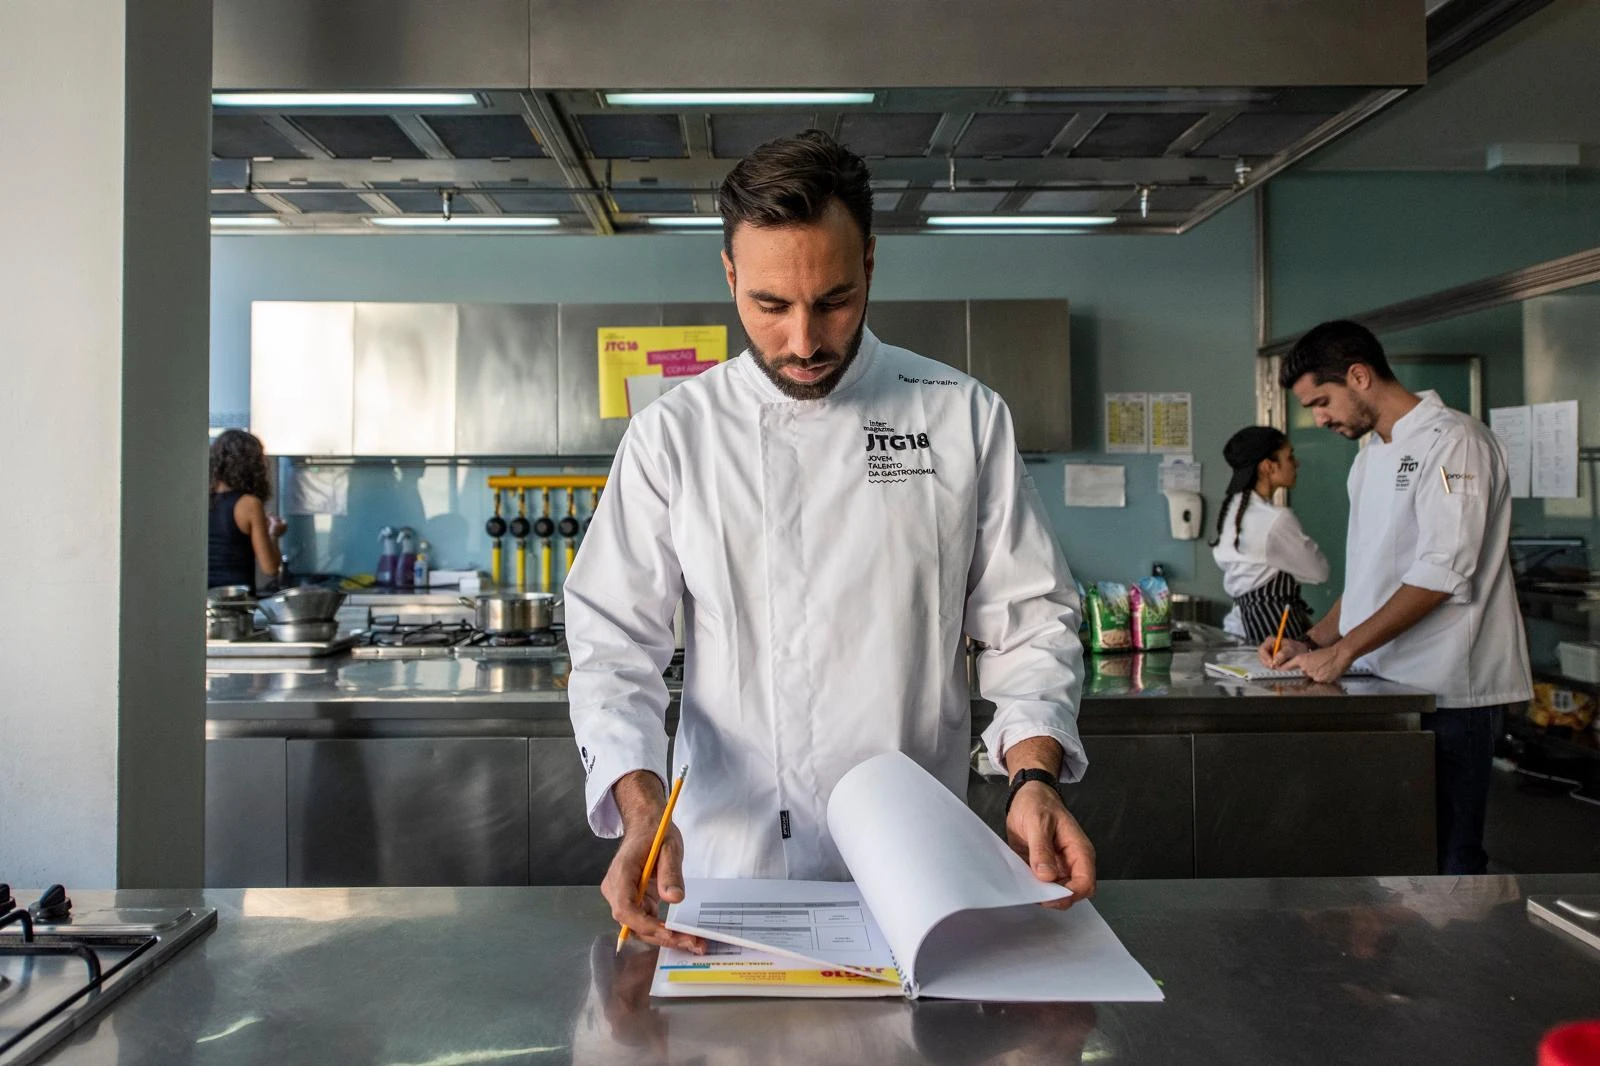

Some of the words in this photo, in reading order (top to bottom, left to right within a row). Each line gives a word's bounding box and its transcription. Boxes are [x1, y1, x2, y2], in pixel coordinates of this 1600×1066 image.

[898, 374, 920, 384] Paulo
[866, 432, 930, 451] JTG18
[881, 468, 937, 477] GASTRONOMIA
